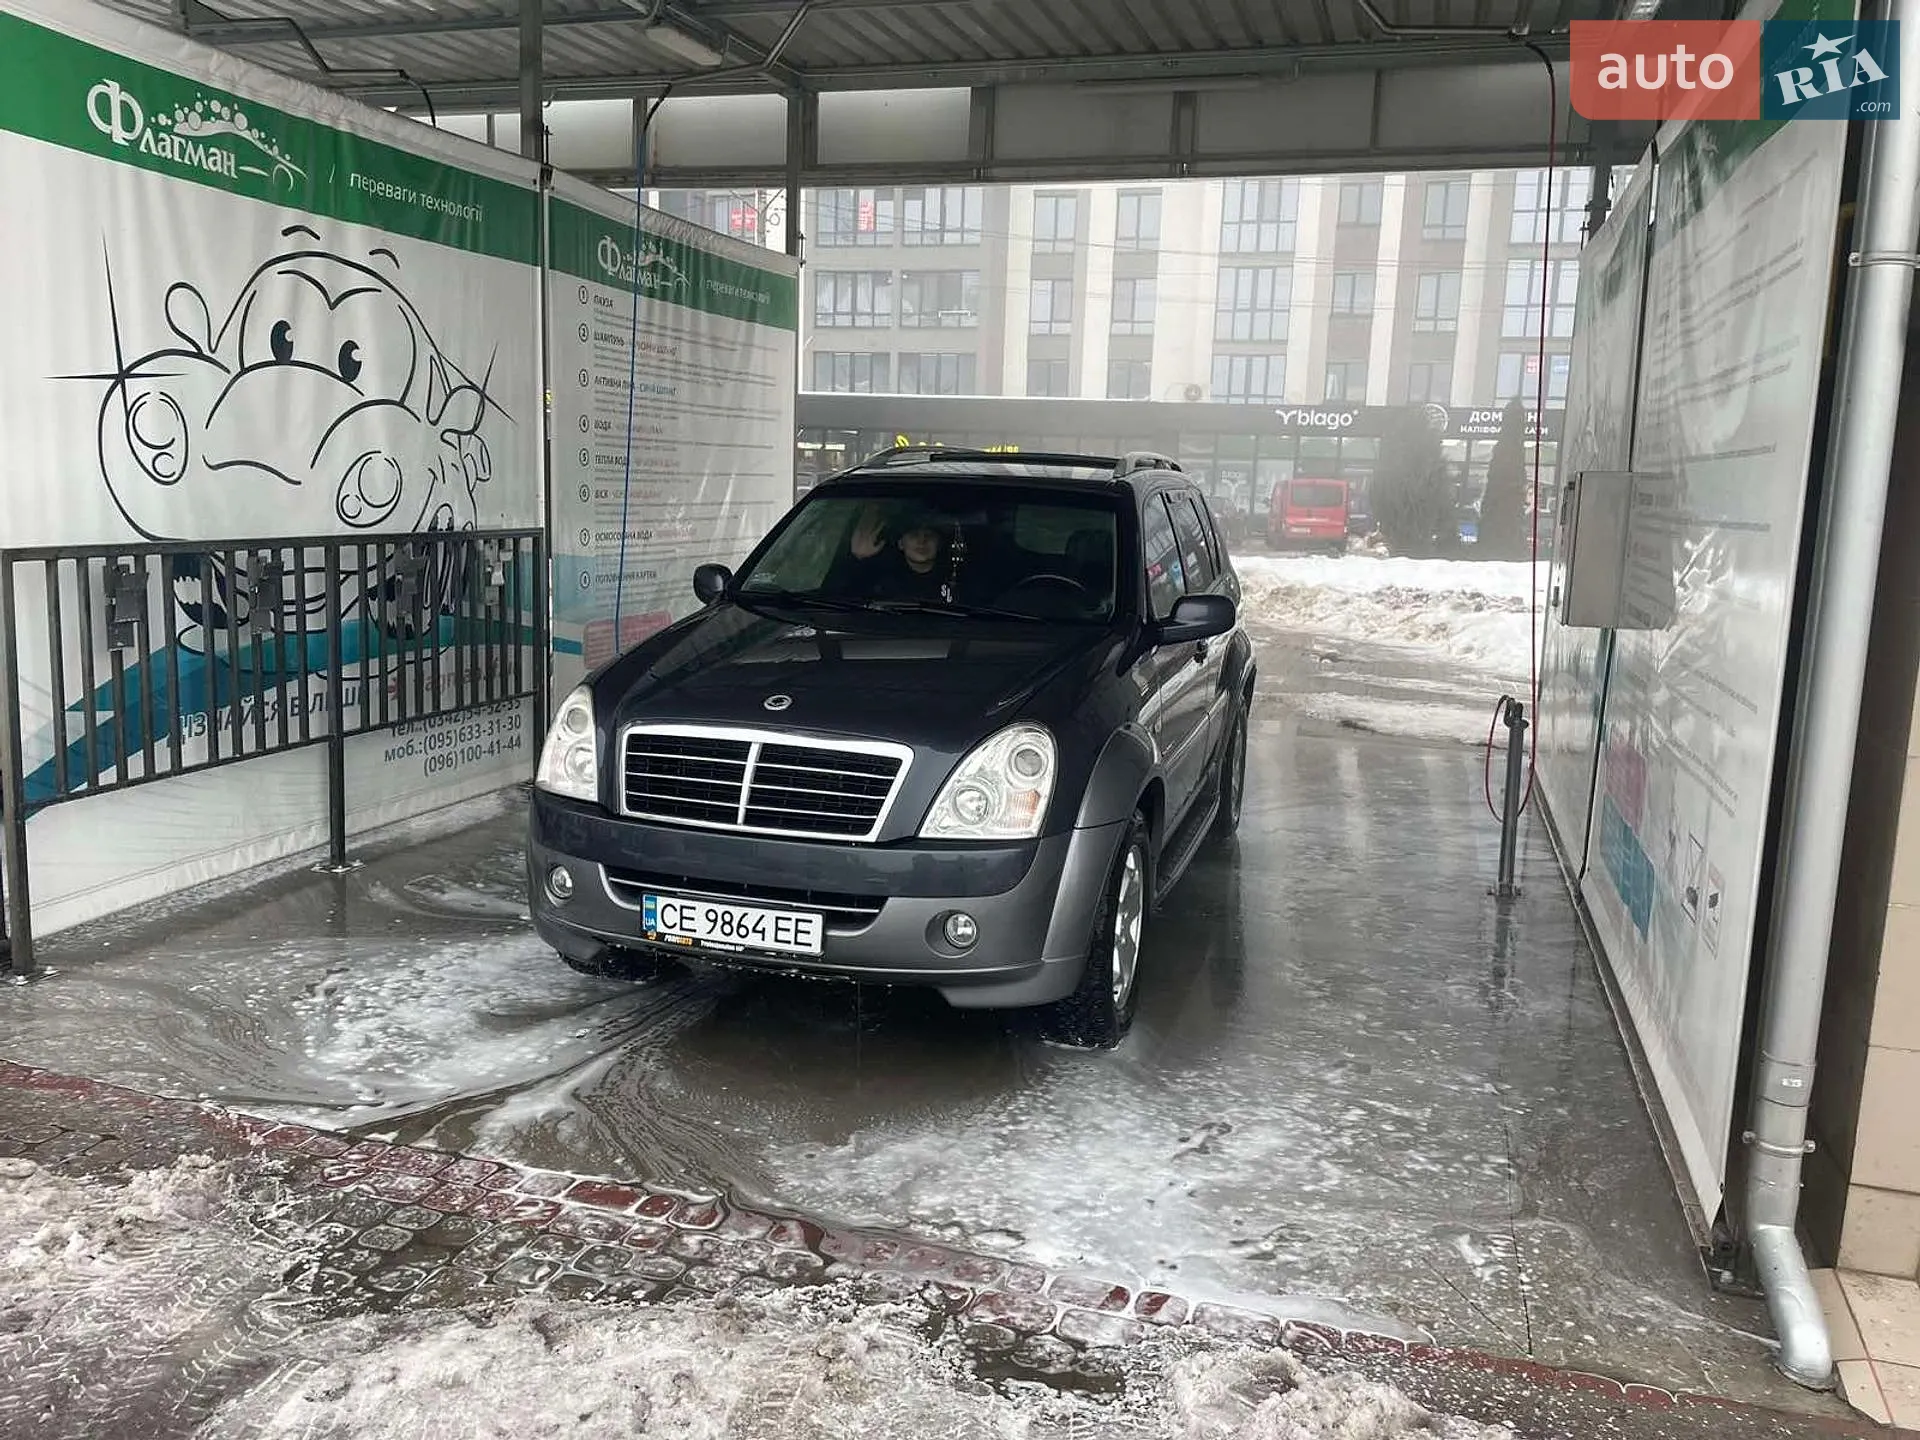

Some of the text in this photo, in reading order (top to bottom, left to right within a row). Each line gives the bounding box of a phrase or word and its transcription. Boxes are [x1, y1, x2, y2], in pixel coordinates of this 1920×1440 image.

[86, 78, 239, 179] Флагман
[350, 172, 484, 222] переваги технології
[1297, 409, 1353, 430] blago
[660, 903, 698, 933] CE
[704, 908, 767, 942] 9864
[773, 915, 814, 947] EE
